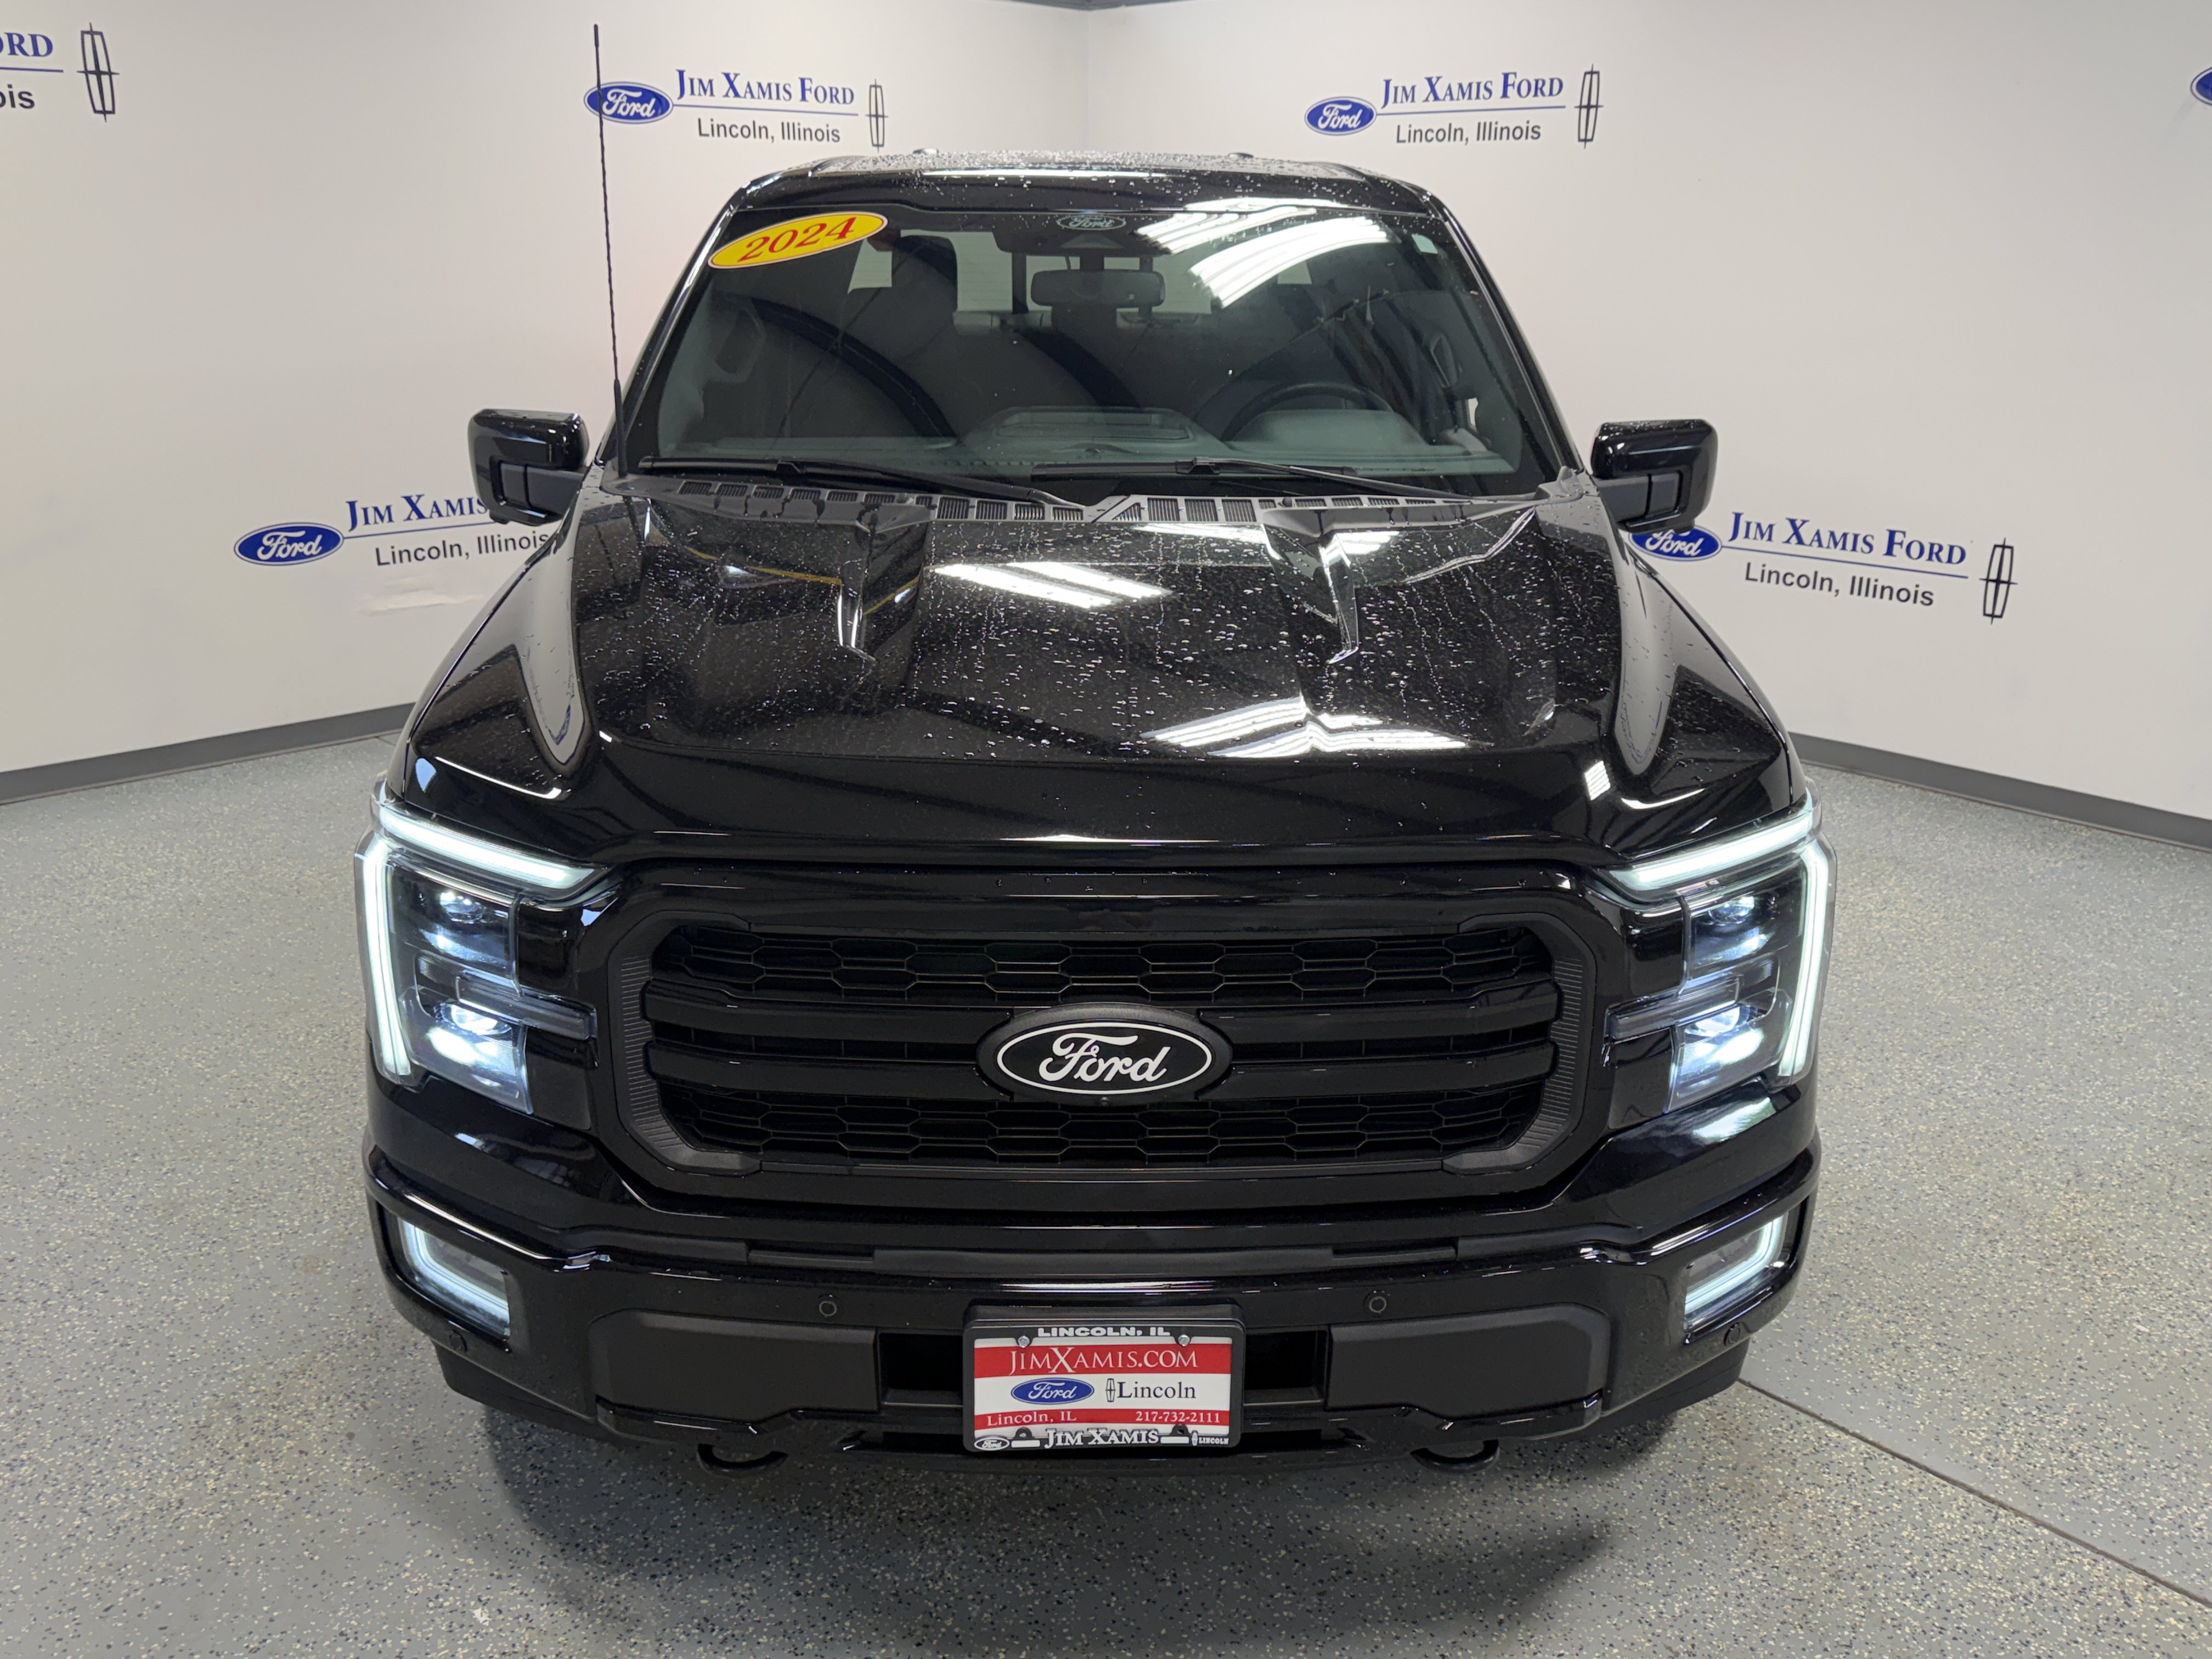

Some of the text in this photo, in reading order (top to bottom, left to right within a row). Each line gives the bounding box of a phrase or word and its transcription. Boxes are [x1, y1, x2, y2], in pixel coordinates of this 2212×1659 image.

[0, 32, 53, 57] RD
[675, 69, 855, 105] JIM XAMIS FORD
[1381, 72, 1564, 109] JIM XAMIS FORD
[602, 88, 656, 117] Ford
[1318, 104, 1362, 129] Ford
[698, 117, 841, 143] Lincoln, Illinois
[1396, 120, 1542, 145] Lincoln, Illinois
[737, 217, 857, 263] 2024
[346, 499, 394, 532] JIM
[257, 530, 323, 560] Ford
[375, 531, 549, 567] Lincoln, Illinois
[1729, 512, 1967, 565] JIM XAMIS FORD
[1745, 562, 1934, 606] Lincoln, Illinois
[1039, 1032, 1171, 1082] Ford
[1150, 1327, 1171, 1336] IL
[1009, 1347, 1198, 1375] JIMXAMIS.COM
[1028, 1382, 1076, 1400] Ford
[1117, 1381, 1196, 1399] Lincoln
[987, 1411, 1076, 1426] Lincoln, IL
[1136, 1411, 1220, 1423] 217-732-2111
[1045, 1429, 1159, 1448] JIM XAMIS
